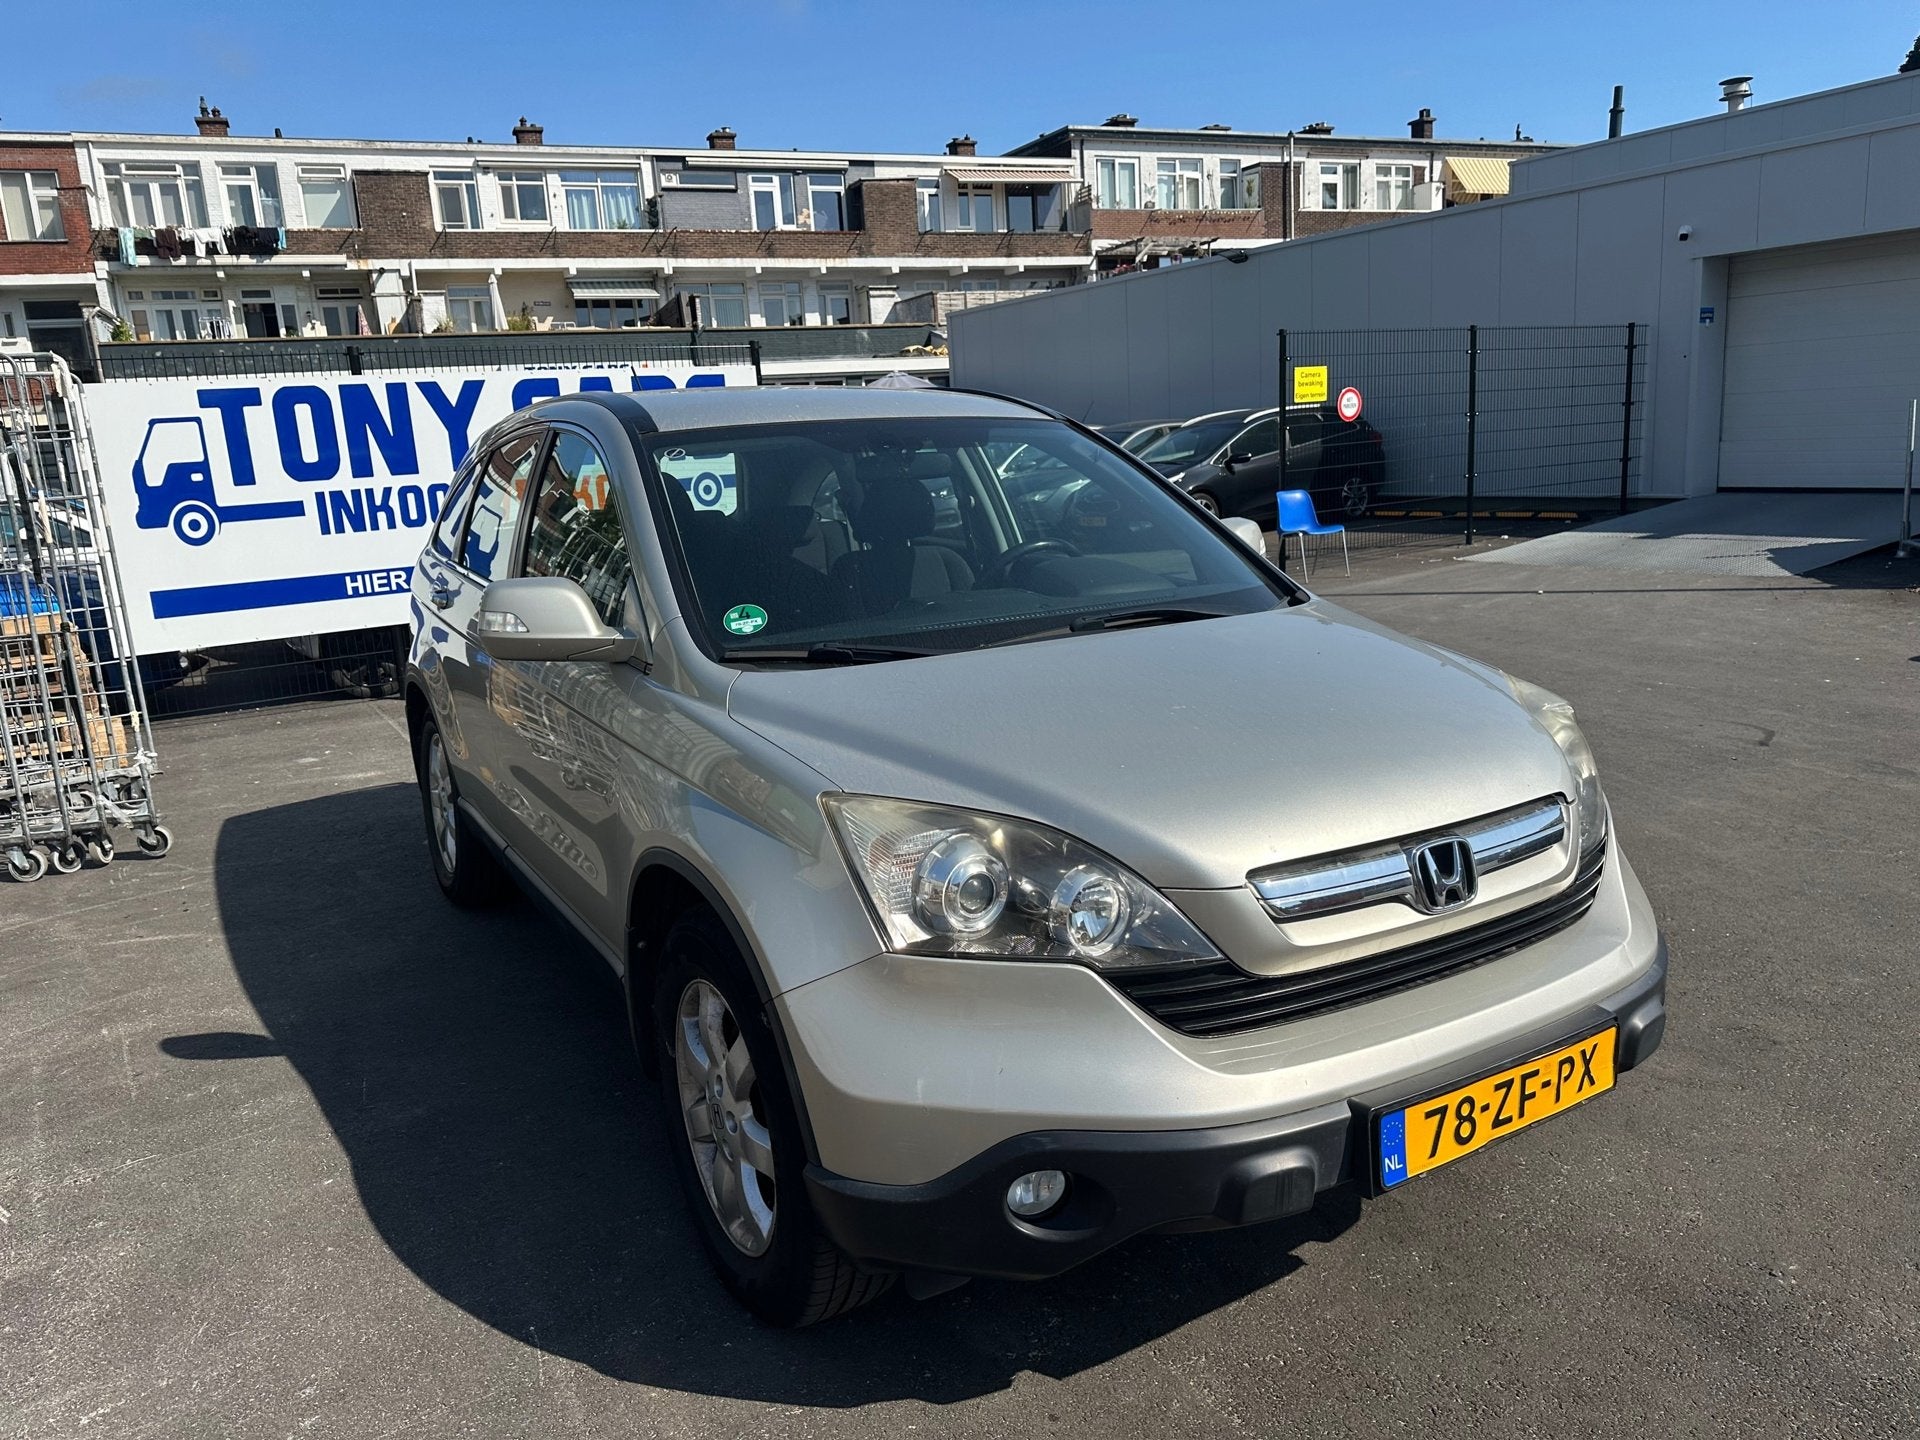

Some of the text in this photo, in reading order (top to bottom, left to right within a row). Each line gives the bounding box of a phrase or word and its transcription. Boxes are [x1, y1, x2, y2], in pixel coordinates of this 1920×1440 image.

[1298, 380, 1323, 388] bewaking
[1295, 392, 1310, 400] Eigen
[196, 379, 486, 488] TONY
[344, 570, 410, 596] HIER
[1424, 1042, 1599, 1160] 78-ZF-PX
[1384, 1154, 1403, 1173] NL
